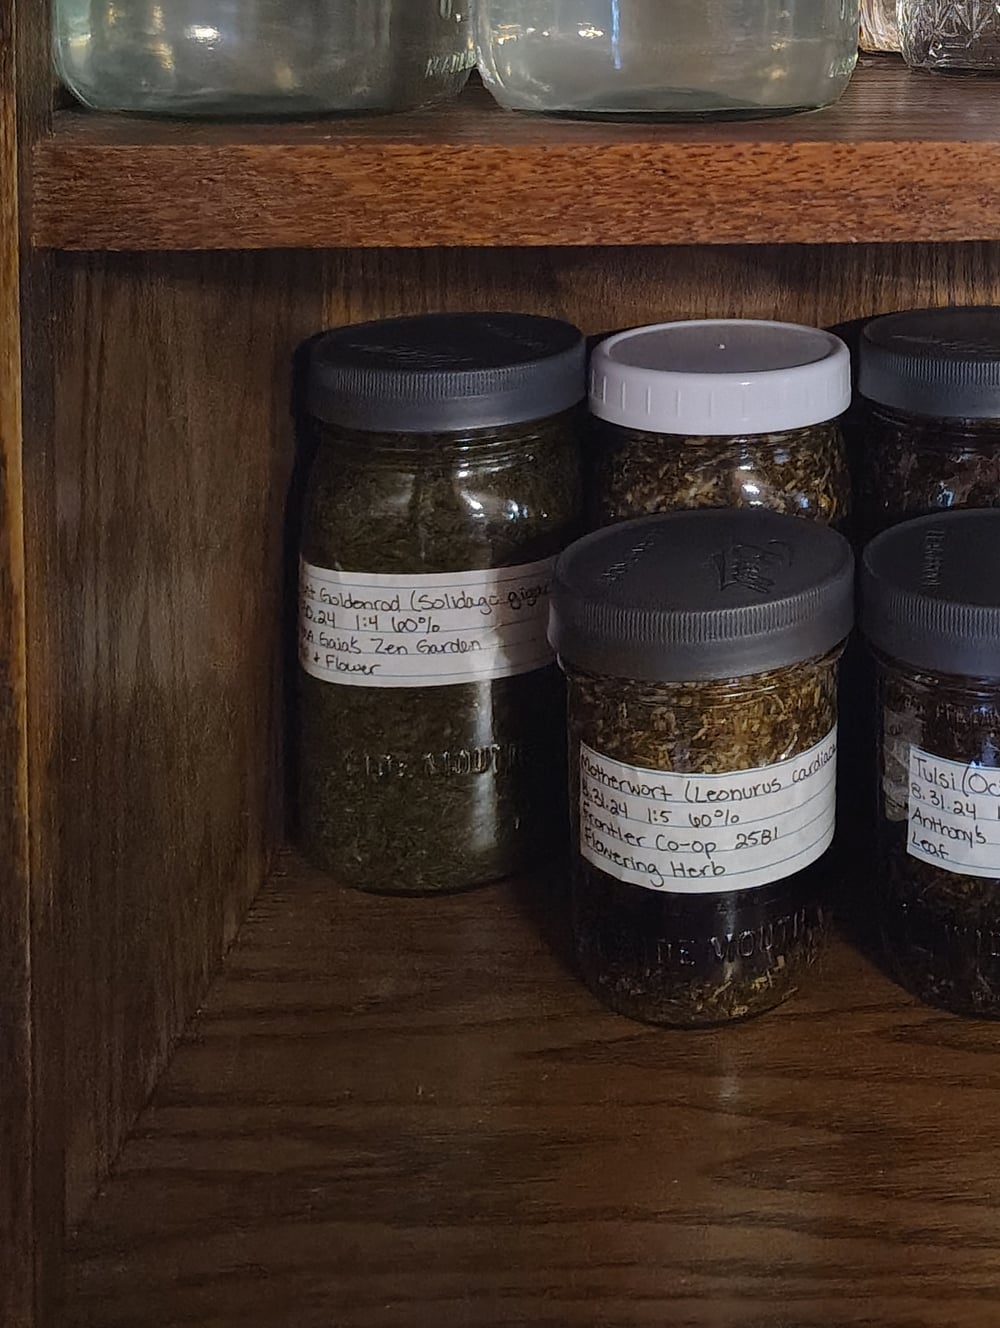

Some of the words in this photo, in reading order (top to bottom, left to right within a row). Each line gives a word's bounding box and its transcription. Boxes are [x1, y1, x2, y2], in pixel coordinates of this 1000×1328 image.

[320, 587, 400, 612] Goldenrod
[356, 613, 379, 631] 1:4
[391, 616, 441, 634] 60%
[370, 638, 409, 655] Zen
[416, 638, 482, 655] Garden
[325, 654, 382, 676] Flower
[581, 753, 673, 802] Motherwort
[685, 777, 782, 803] (Leonurus
[913, 755, 956, 791] Tulsi
[911, 782, 977, 821] 8.31.24
[647, 807, 673, 824] 1:5
[688, 809, 740, 828] 60%
[911, 806, 987, 849] Anthony's
[655, 833, 717, 860] Co-op
[911, 831, 949, 860] Leaf
[670, 860, 726, 879] Herb
